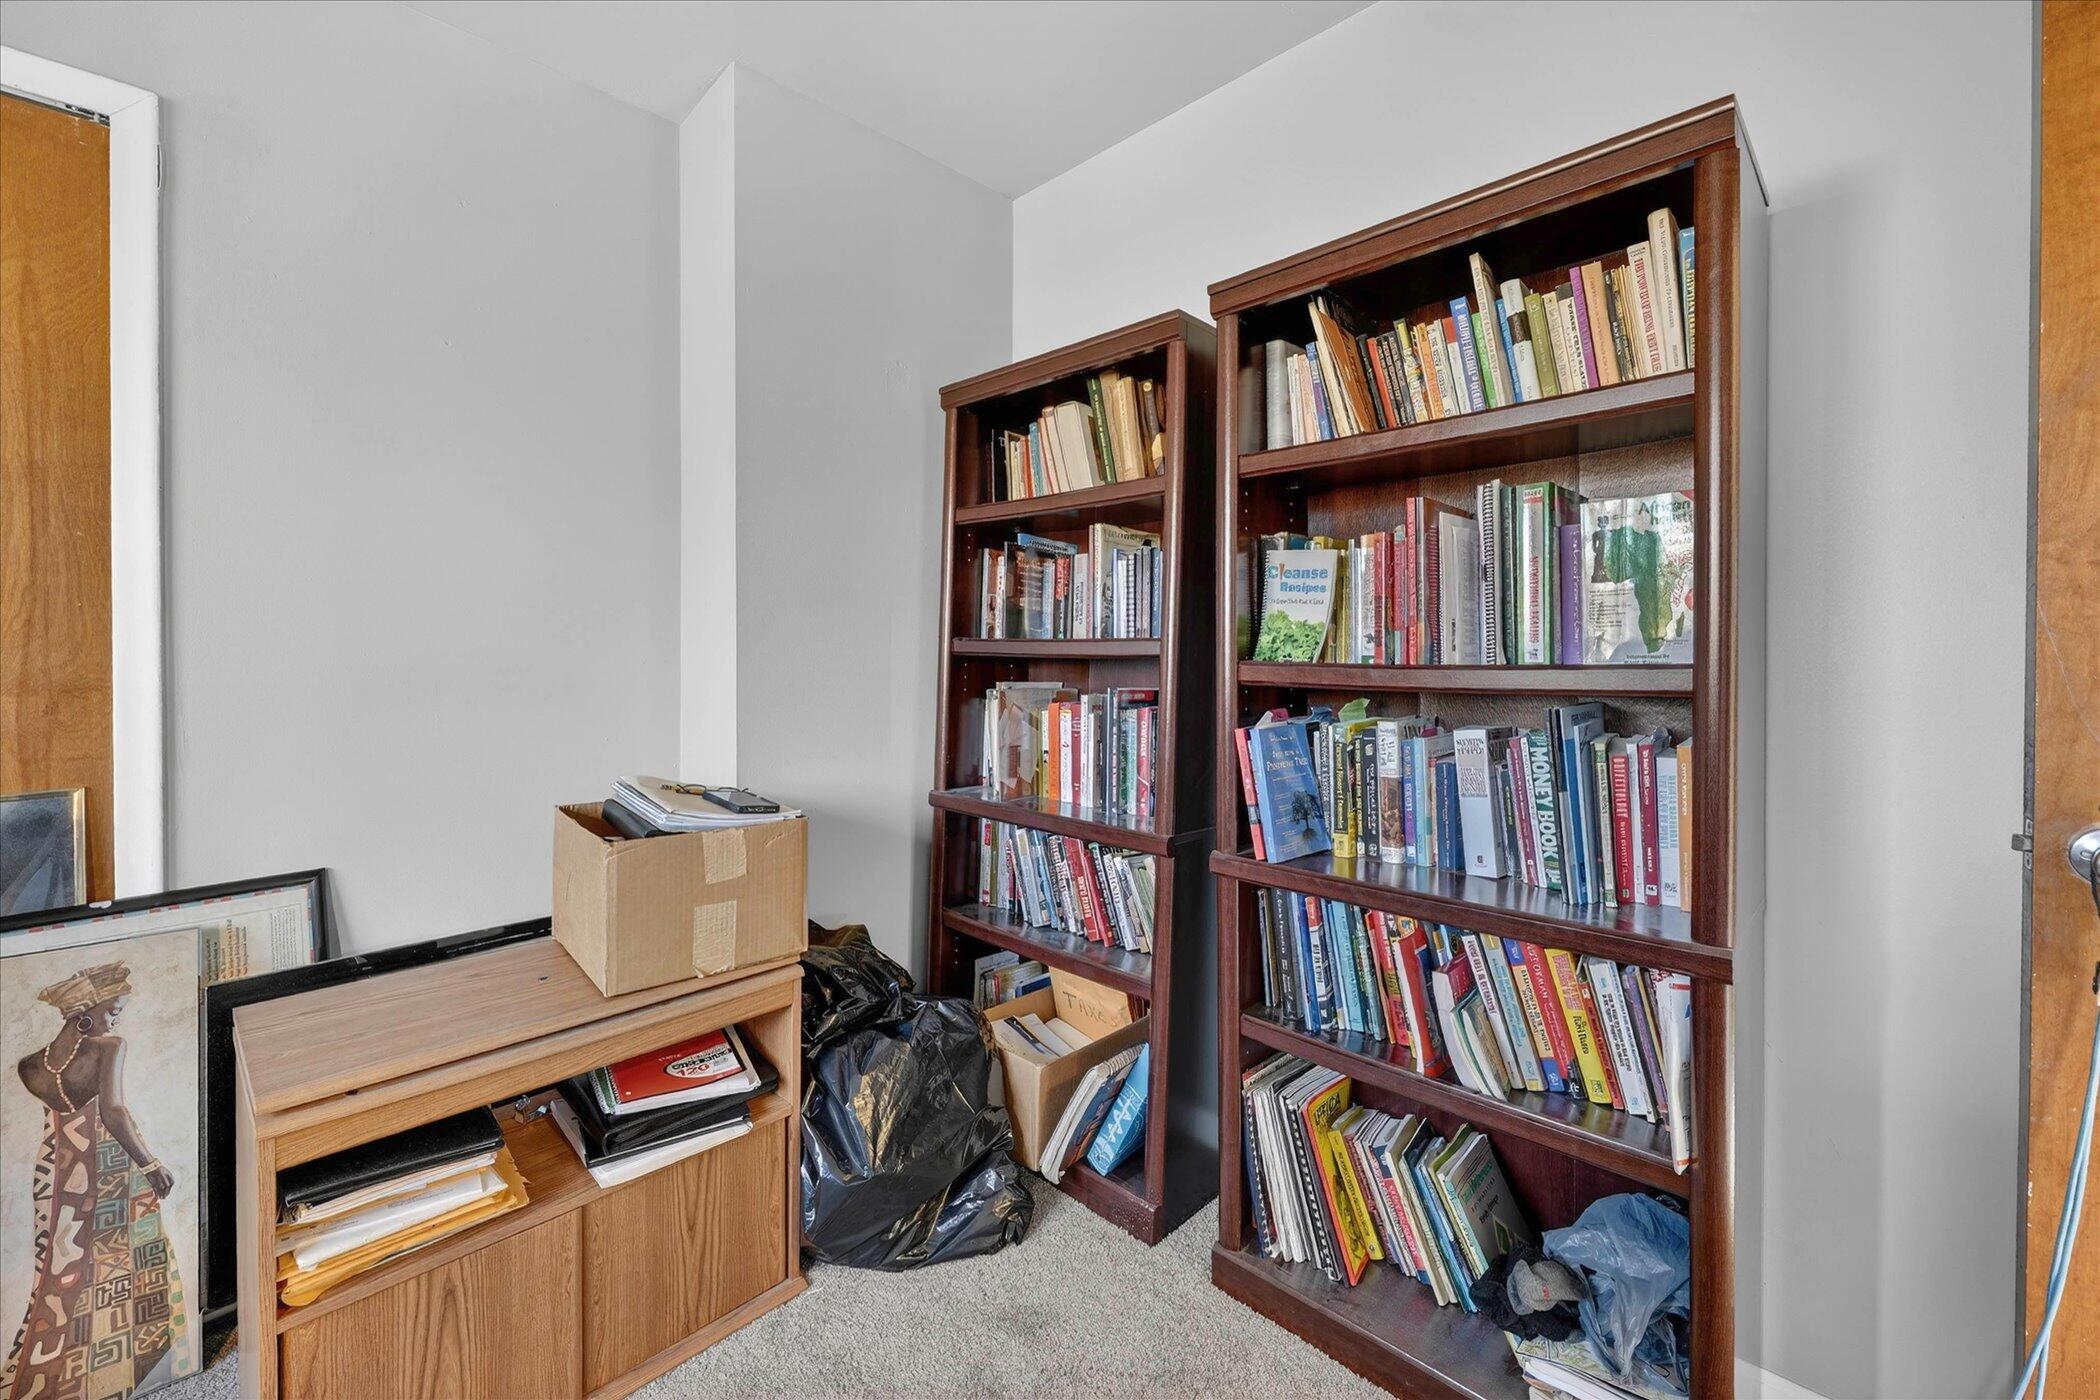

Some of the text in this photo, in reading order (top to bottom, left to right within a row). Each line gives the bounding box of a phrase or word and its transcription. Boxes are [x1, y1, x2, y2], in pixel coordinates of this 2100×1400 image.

[1267, 563, 1328, 580] Cleanse
[1530, 746, 1559, 858] MONEY BOOK
[676, 1063, 710, 1077] 120
